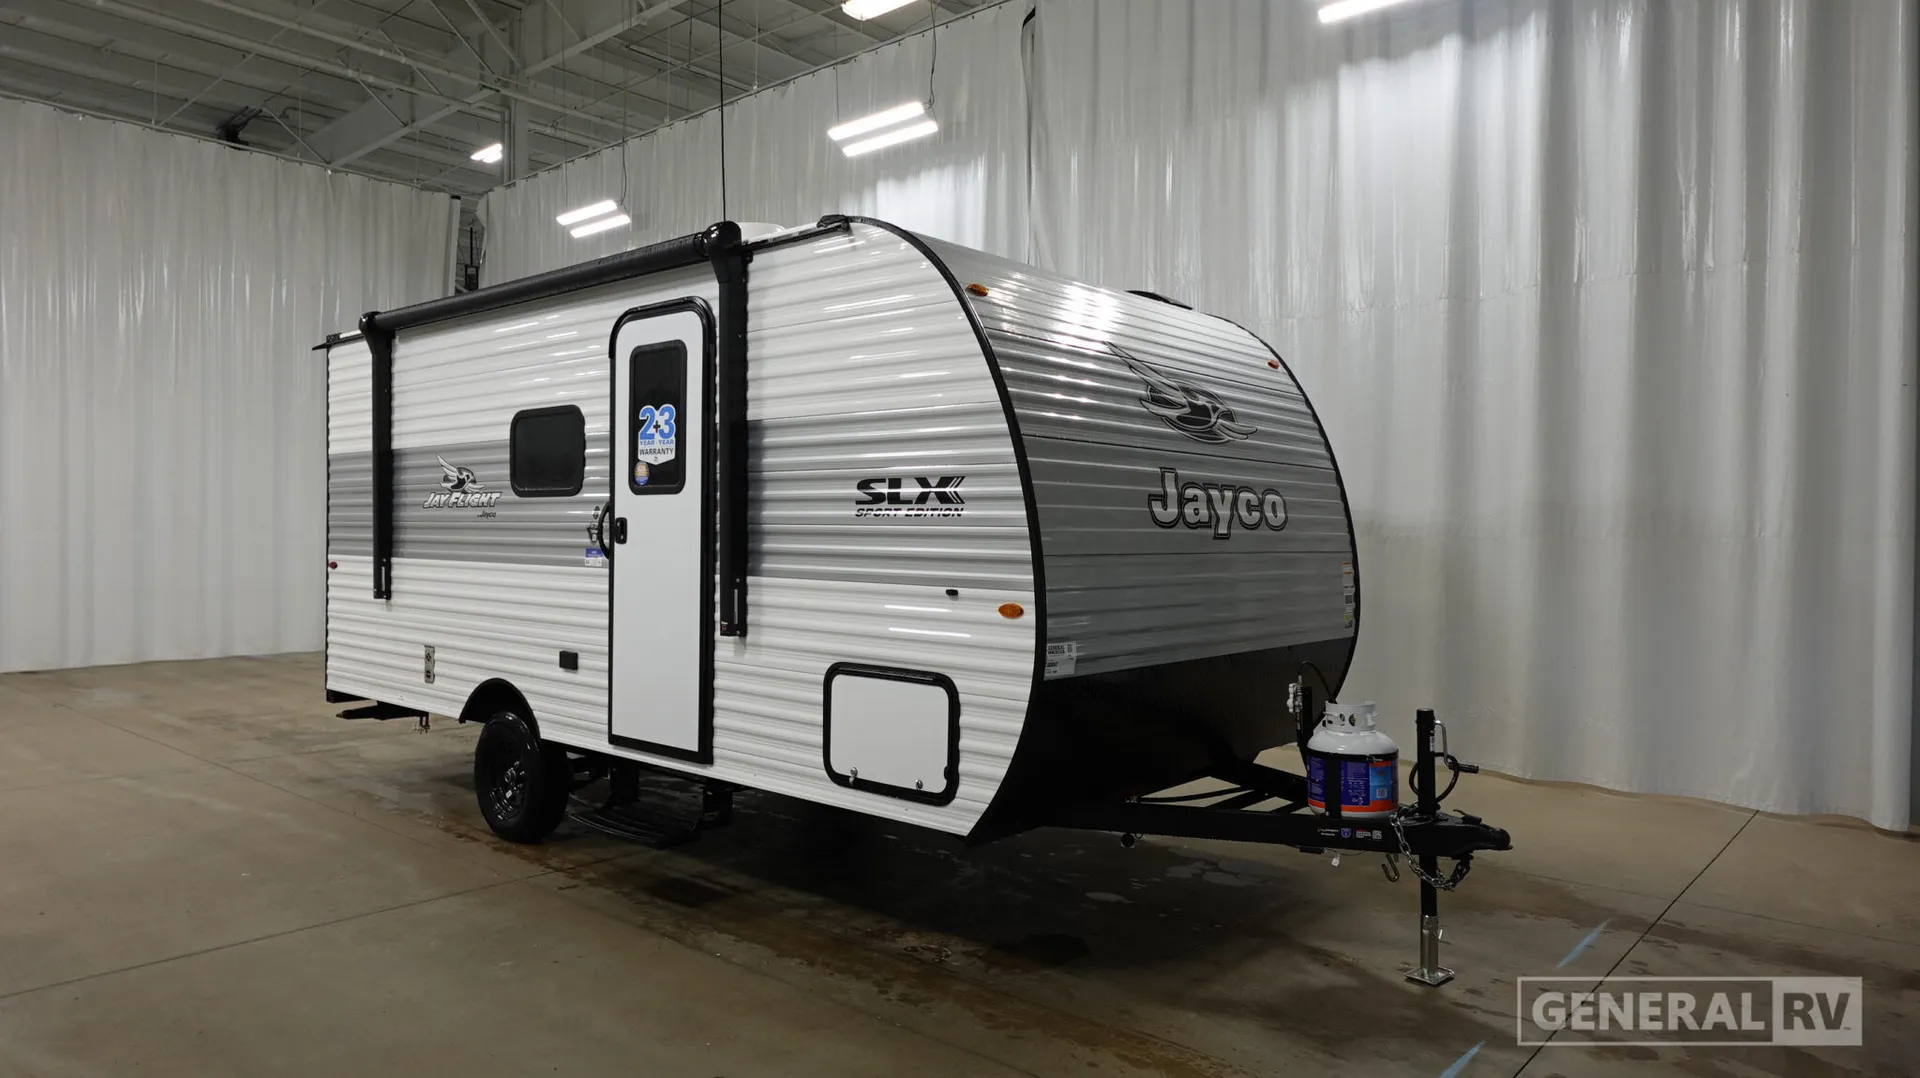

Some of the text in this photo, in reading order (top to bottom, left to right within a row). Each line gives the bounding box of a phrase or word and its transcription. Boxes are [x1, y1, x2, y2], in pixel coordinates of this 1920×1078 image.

[639, 447, 674, 456] WARRANTY
[855, 476, 965, 505] SLX
[423, 491, 501, 509] JAY FLIGHT
[1148, 467, 1288, 540] Jayco
[855, 507, 964, 518] SPORT EDITION
